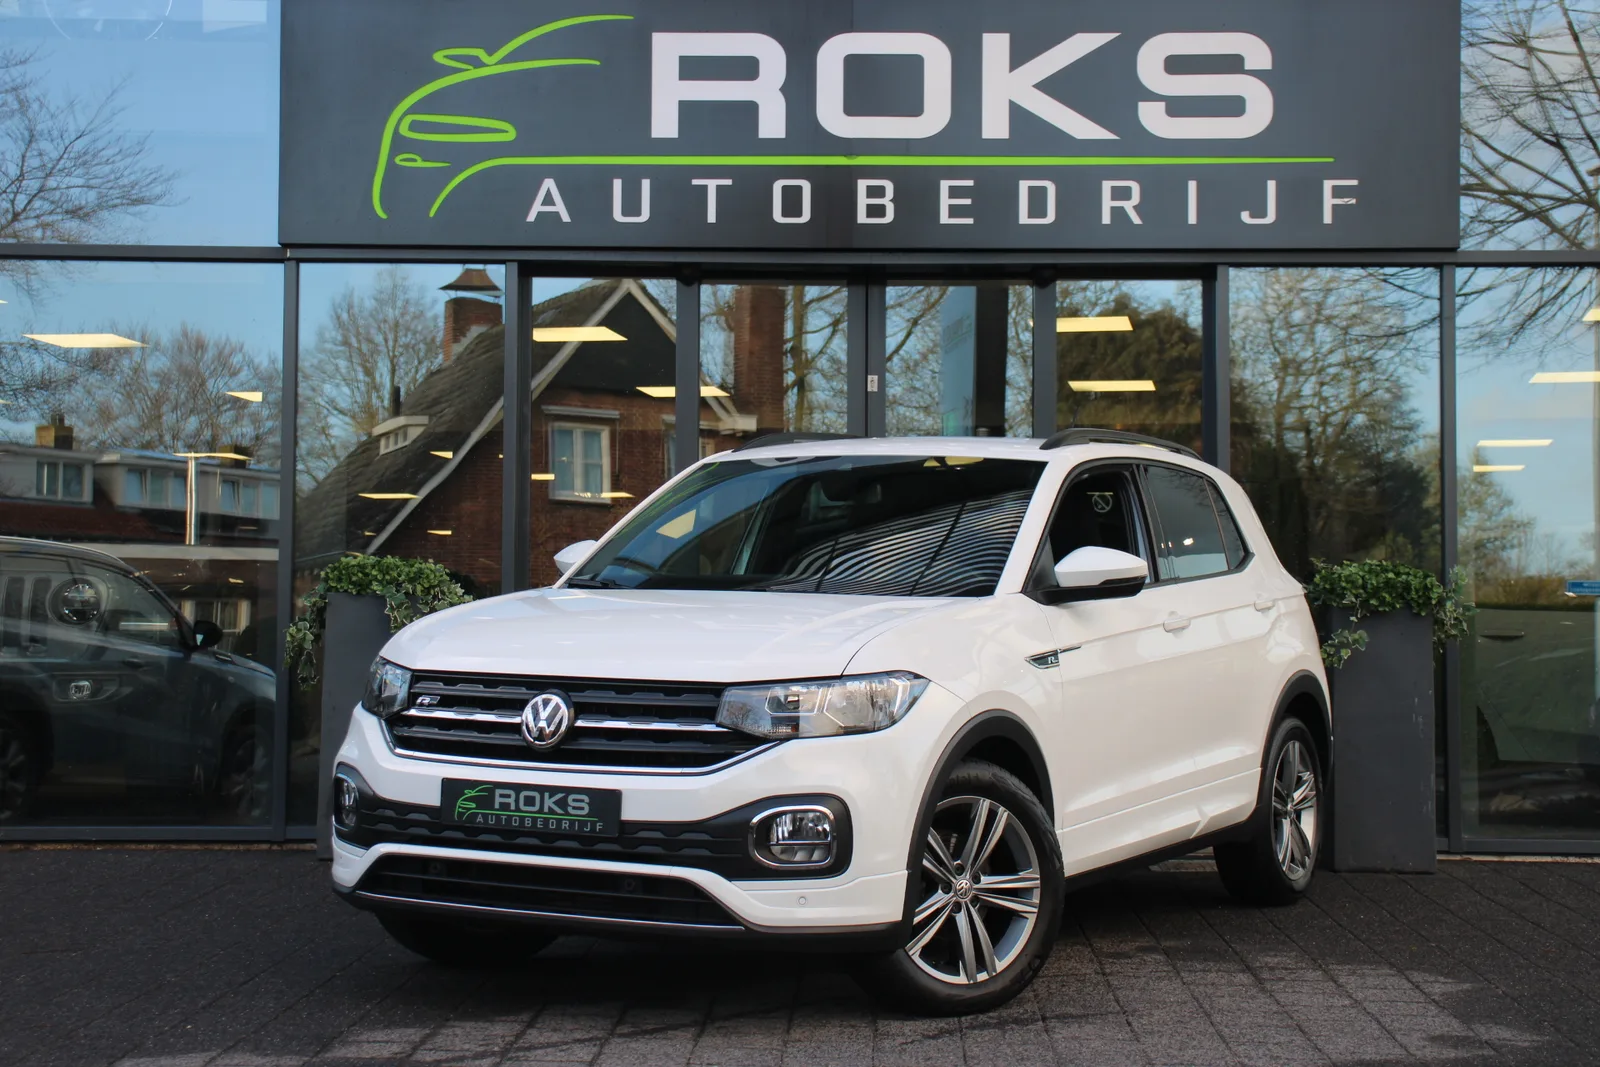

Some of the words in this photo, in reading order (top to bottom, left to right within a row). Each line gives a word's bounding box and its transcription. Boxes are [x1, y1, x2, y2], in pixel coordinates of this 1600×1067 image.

[650, 32, 1274, 140] ROKS
[526, 178, 1360, 225] AUTOBEDRIJF
[494, 788, 590, 816] ROKS
[476, 813, 604, 832] AUTOBEDRIJF
